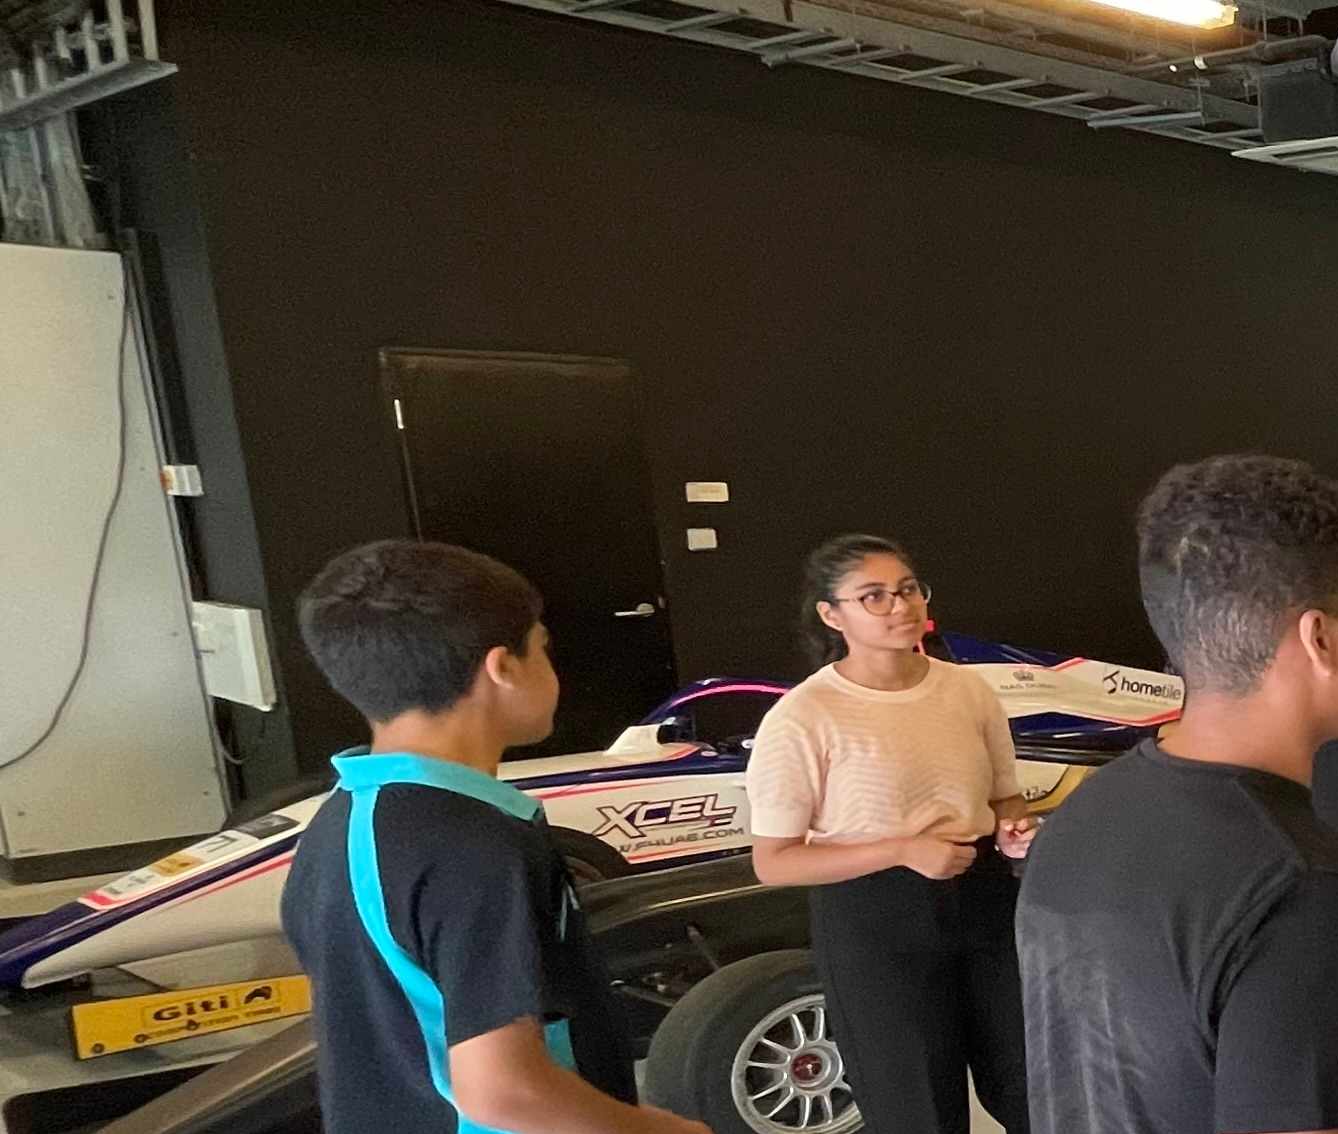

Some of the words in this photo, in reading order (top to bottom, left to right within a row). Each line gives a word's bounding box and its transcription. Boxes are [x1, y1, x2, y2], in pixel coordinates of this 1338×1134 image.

[1120, 677, 1182, 701] hometile
[592, 793, 737, 839] XCEL
[153, 995, 229, 1022] Giti
